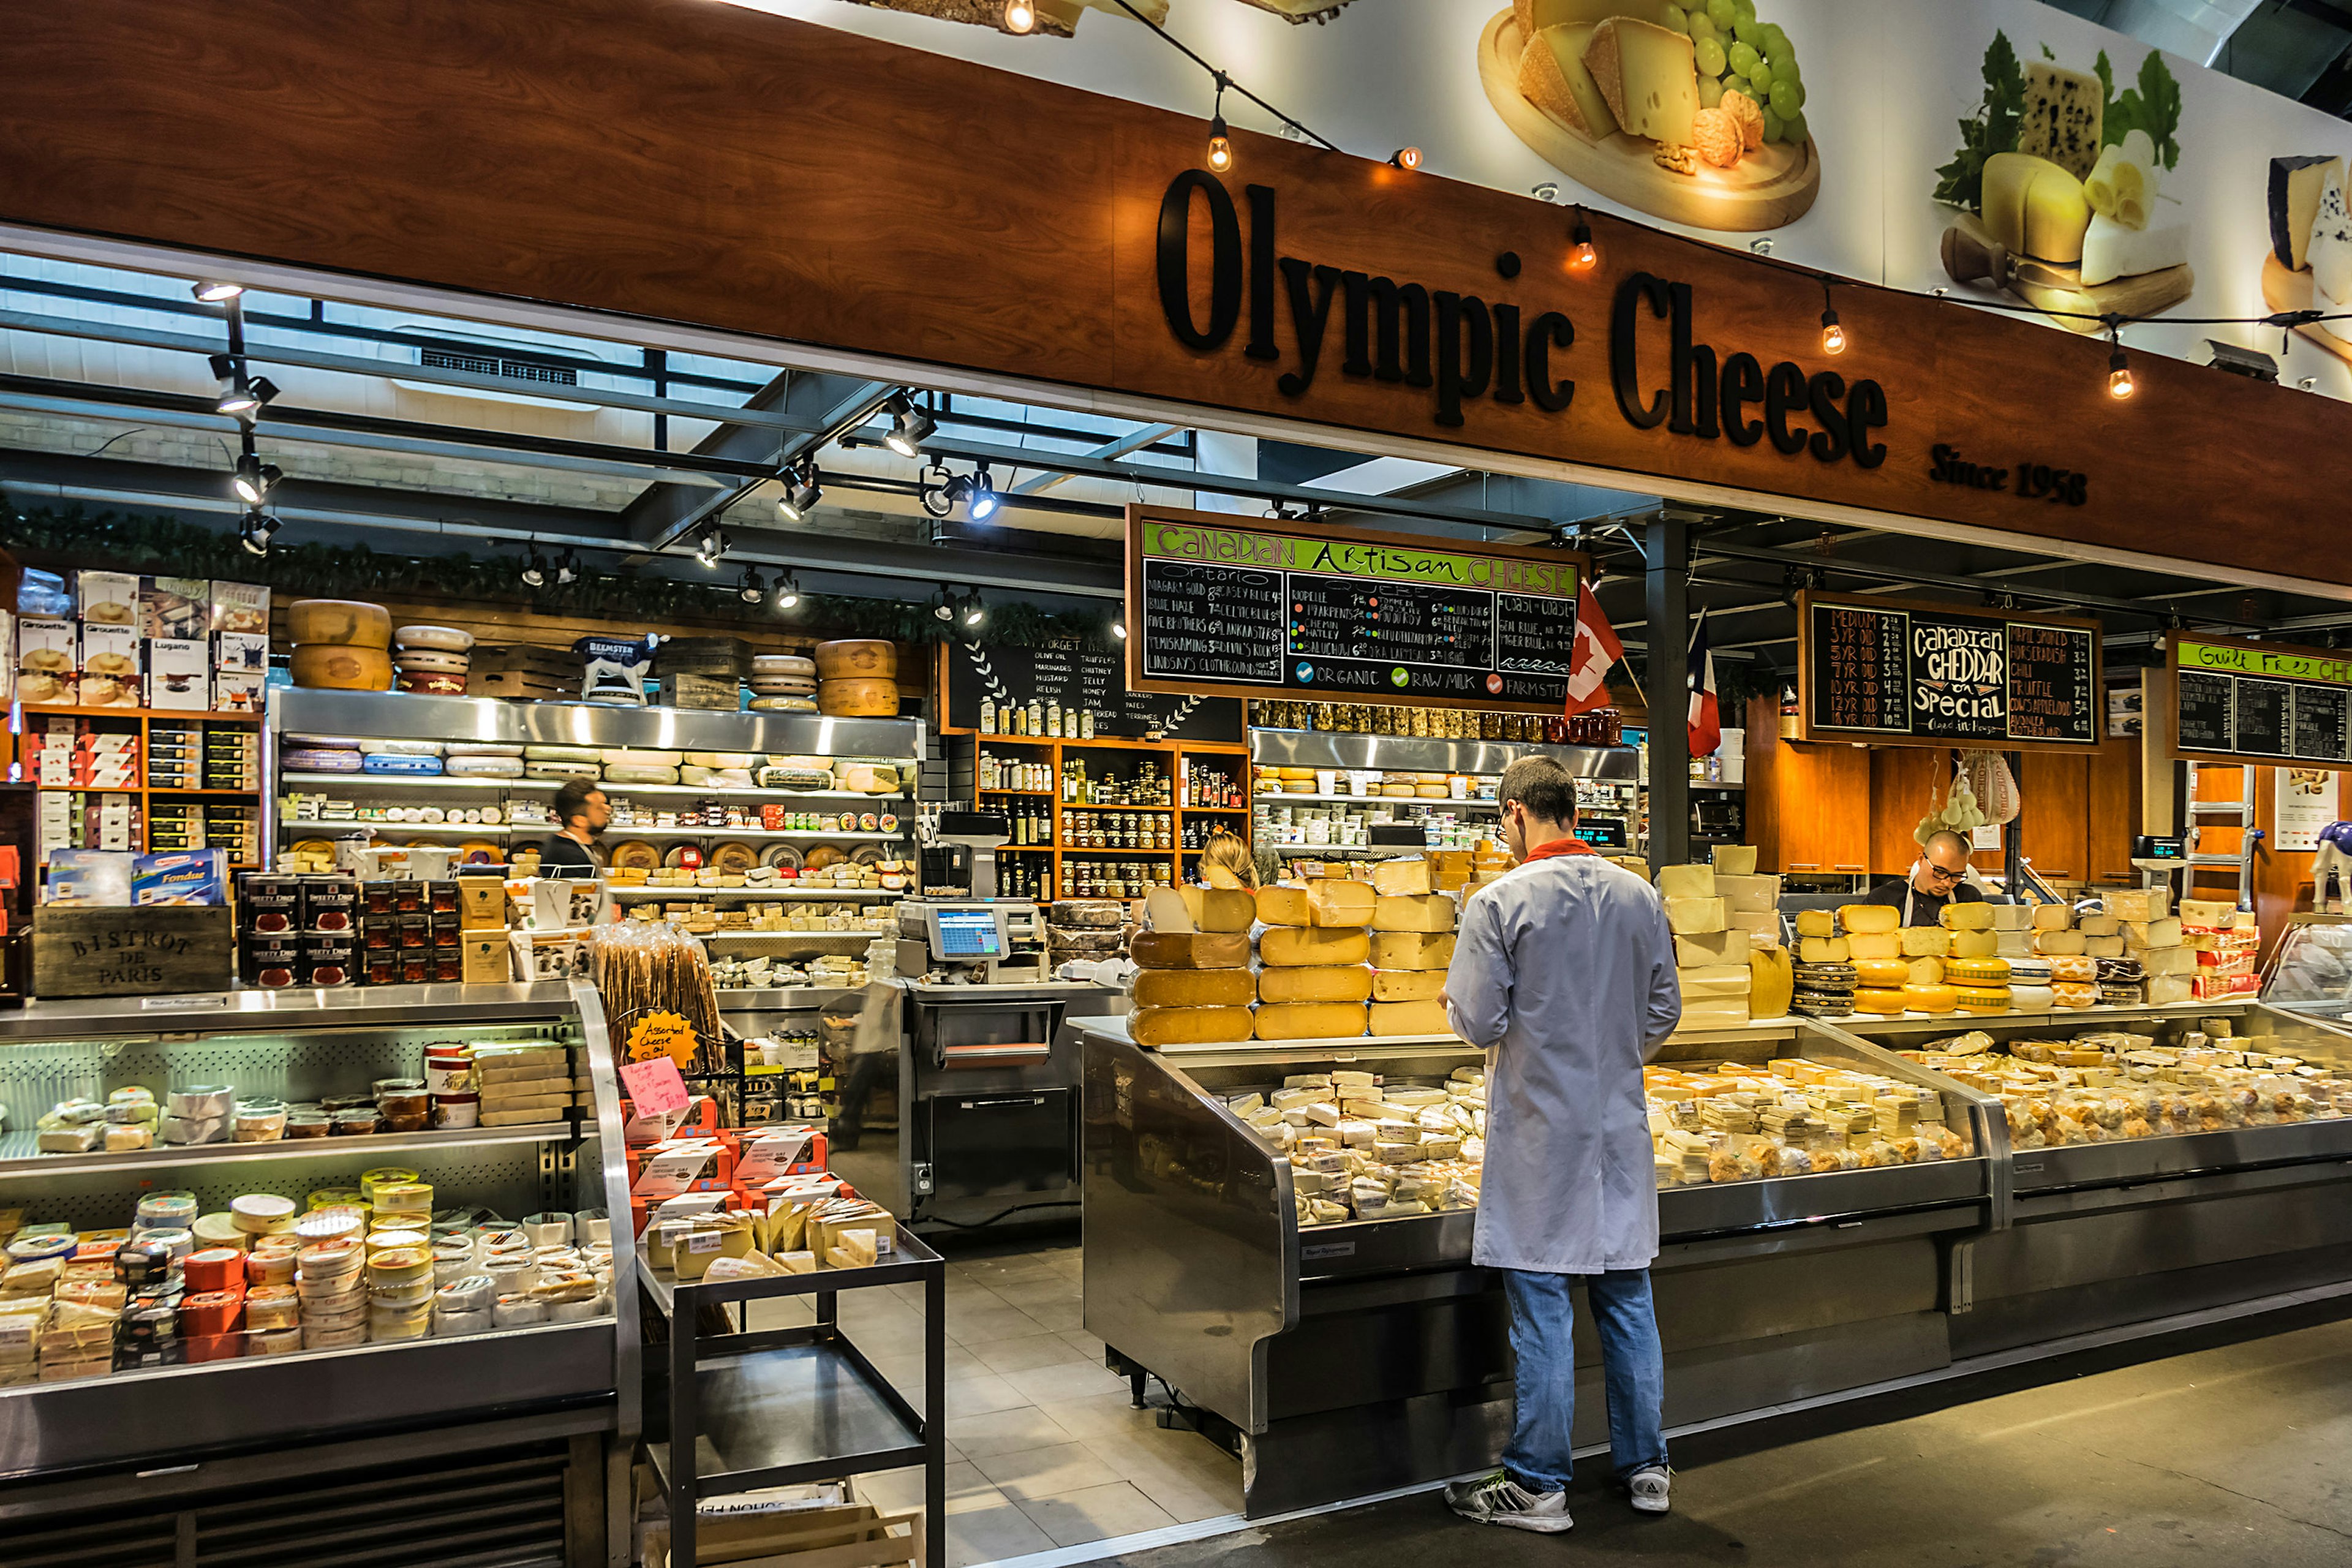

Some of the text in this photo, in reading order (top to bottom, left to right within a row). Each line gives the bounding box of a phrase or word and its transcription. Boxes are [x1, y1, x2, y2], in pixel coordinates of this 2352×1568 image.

[1156, 168, 1890, 469] Olympic Cheese
[1930, 443, 2087, 507] Since 1958
[1468, 559, 1567, 594] CHEESE
[1250, 589, 1271, 601] BLUE
[1291, 589, 1328, 603] RIOPELLE
[1172, 600, 1194, 614] HAZE
[1251, 608, 1271, 620] BLUE
[21, 620, 68, 631] Girouette
[1166, 616, 1207, 633] BROTHERS
[1305, 618, 1338, 630] CHEMIN
[1831, 609, 1876, 630] MEDIUM
[85, 625, 130, 635] Girouette
[1305, 629, 1340, 640] HATLEY
[1830, 626, 1839, 643] 3
[1841, 628, 1856, 644] YR
[1860, 628, 1876, 646] OLD
[154, 641, 190, 651] Lugano
[589, 642, 634, 654] BEEMSTER
[1253, 643, 1272, 657] ROCK
[1830, 645, 1841, 661] 5
[1842, 645, 1857, 661] YR
[1860, 647, 1877, 662] OLD
[2010, 643, 2067, 665] HORSERADISH
[1080, 655, 1117, 665] TRUFFLES
[1148, 654, 1196, 671] LINDSAY'S
[1199, 658, 1256, 676] CLOTHBOUND
[1928, 646, 2003, 684] CHEDDAR
[2198, 646, 2251, 670] Guilt
[1035, 663, 1072, 672] MARINADES
[1316, 666, 1379, 685] ORGANIC
[1831, 662, 1841, 678] 7
[1843, 662, 1858, 678] YR
[1861, 663, 1877, 679] OLD
[2010, 662, 2032, 678] CHILI
[1082, 677, 1106, 685] JELLY
[1412, 672, 1476, 690] RAW MILK
[1506, 679, 1566, 698] FARMSTEA
[1830, 679, 1842, 695] 10
[1844, 680, 1860, 695] YR
[1863, 681, 1879, 695] OLD
[1951, 683, 1974, 695] on
[2010, 679, 2054, 698] TRUFFLE
[1082, 688, 1107, 696] HONEY
[1082, 698, 1102, 707] JAM
[1831, 696, 1844, 711] 12
[1844, 697, 1858, 712] YR
[1863, 697, 1878, 713] OLD
[1125, 712, 1158, 721] TERRINES
[1844, 714, 1858, 726] YR
[1862, 714, 1878, 727] OLD
[162, 870, 206, 884] Fondue
[71, 929, 191, 957] BISTROT
[118, 951, 146, 965] DE
[99, 967, 163, 984] PARIS
[645, 1023, 685, 1036] Assorted
